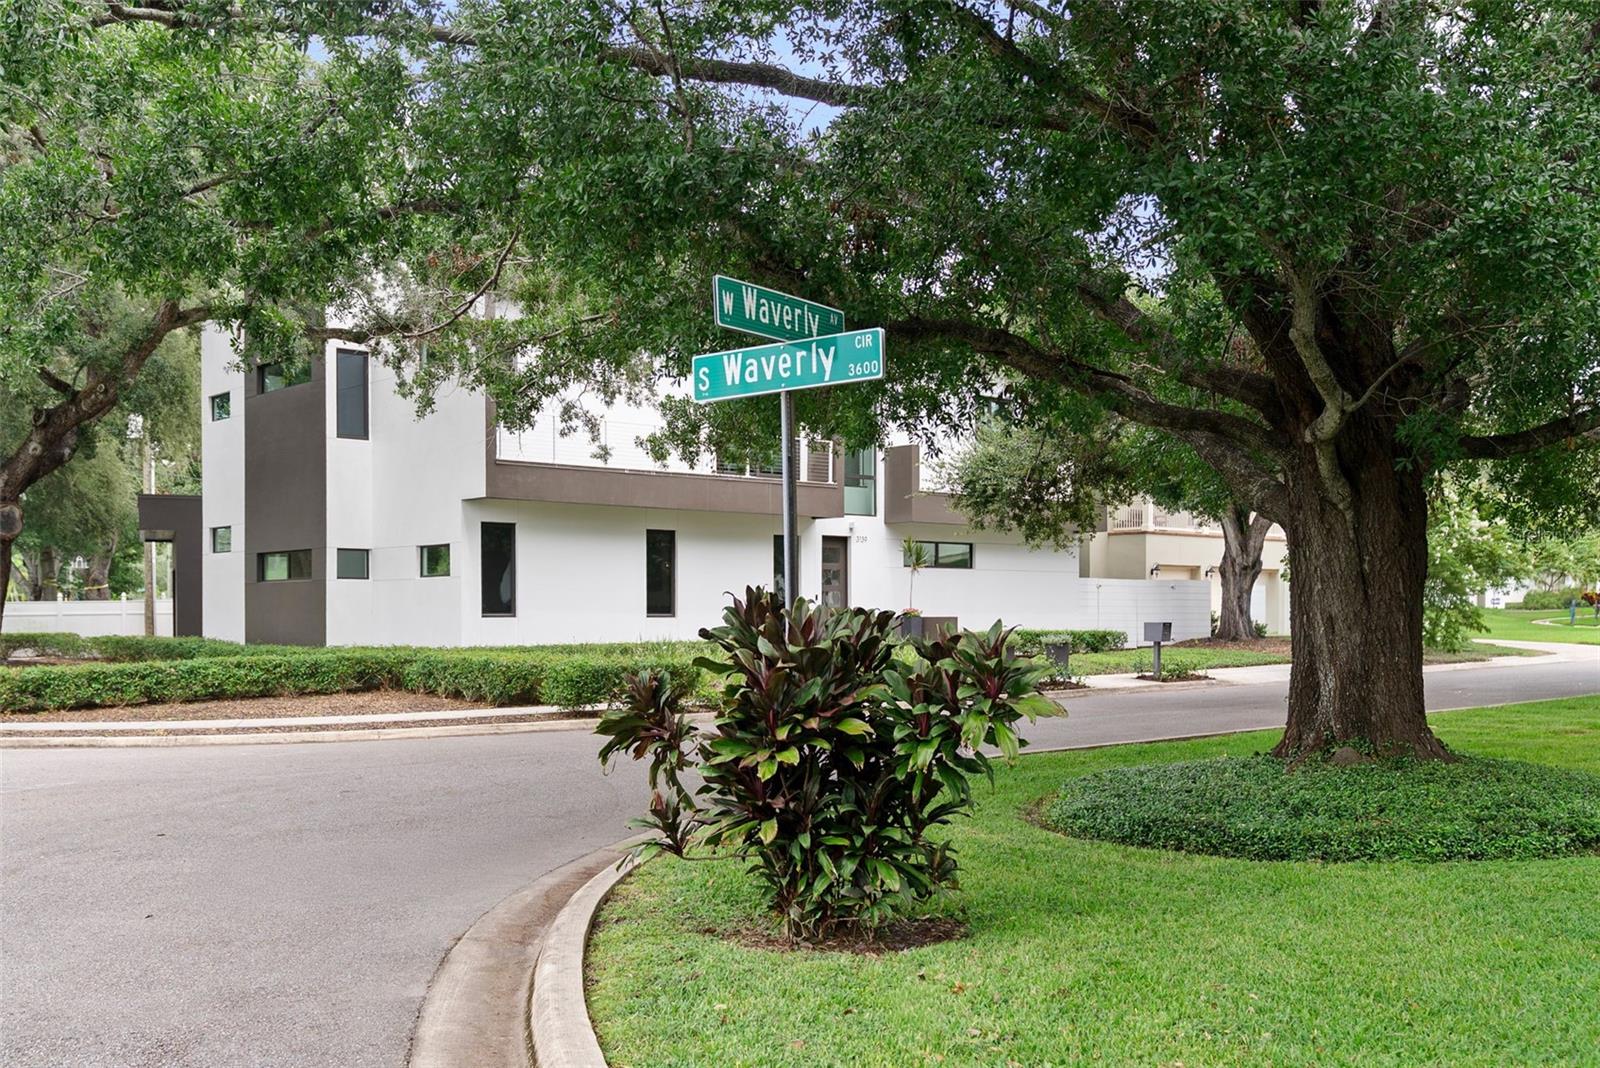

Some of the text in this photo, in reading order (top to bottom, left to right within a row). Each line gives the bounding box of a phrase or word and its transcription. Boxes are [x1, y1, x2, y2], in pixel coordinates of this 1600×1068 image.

[722, 285, 838, 338] W Waverly AV
[698, 334, 873, 392] S Waverly CIR
[848, 360, 879, 377] 3600
